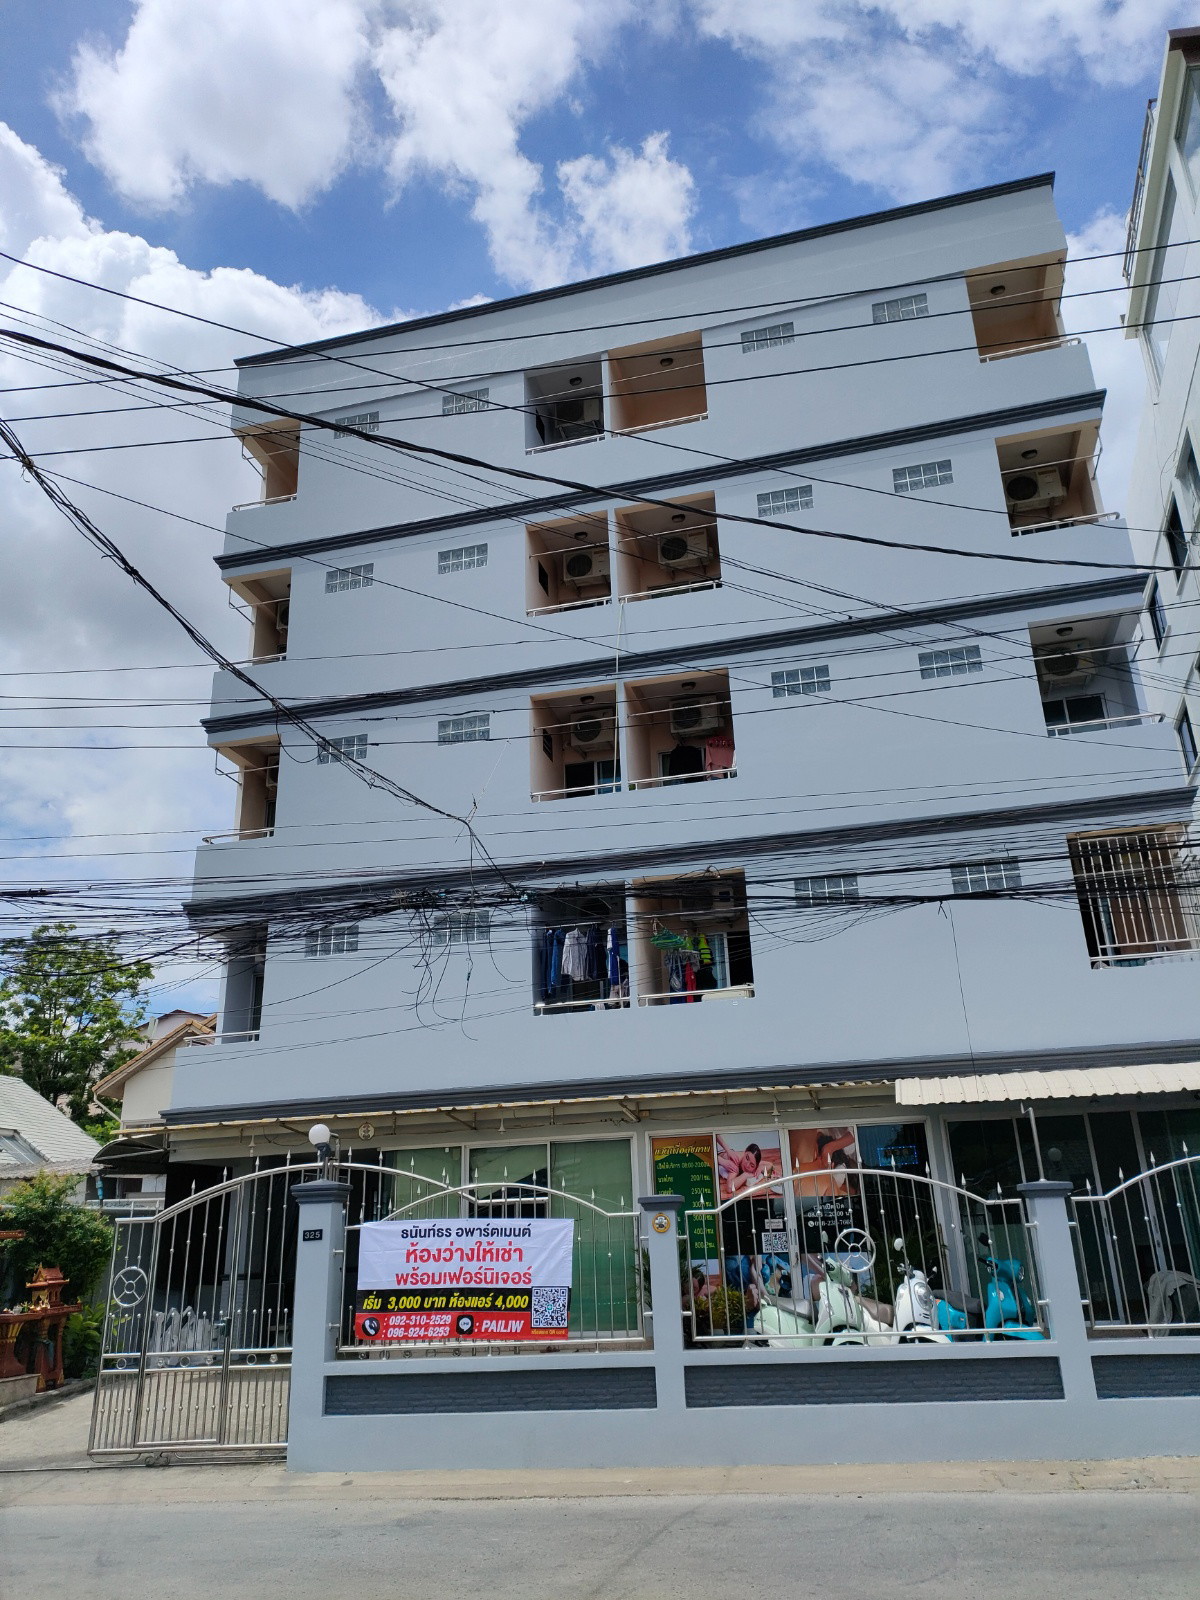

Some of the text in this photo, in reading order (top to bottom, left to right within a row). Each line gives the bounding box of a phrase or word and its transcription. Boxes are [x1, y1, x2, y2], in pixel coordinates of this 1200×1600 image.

[304, 1231, 321, 1239] 325
[401, 1222, 532, 1239] ธนันท์ธร อพาร์ตเมนต์
[405, 1240, 523, 1263] ห้องว่างให้เช่า
[395, 1266, 533, 1286] พร้อมเฟอร์นิเจอร์
[362, 1290, 529, 1312] เริ่ม 3,000 บาท ห้องแอร์ 4,000
[389, 1315, 452, 1326] 092-310-2529
[481, 1319, 525, 1333] PAILIW
[387, 1326, 450, 1338] 096-924-6253
